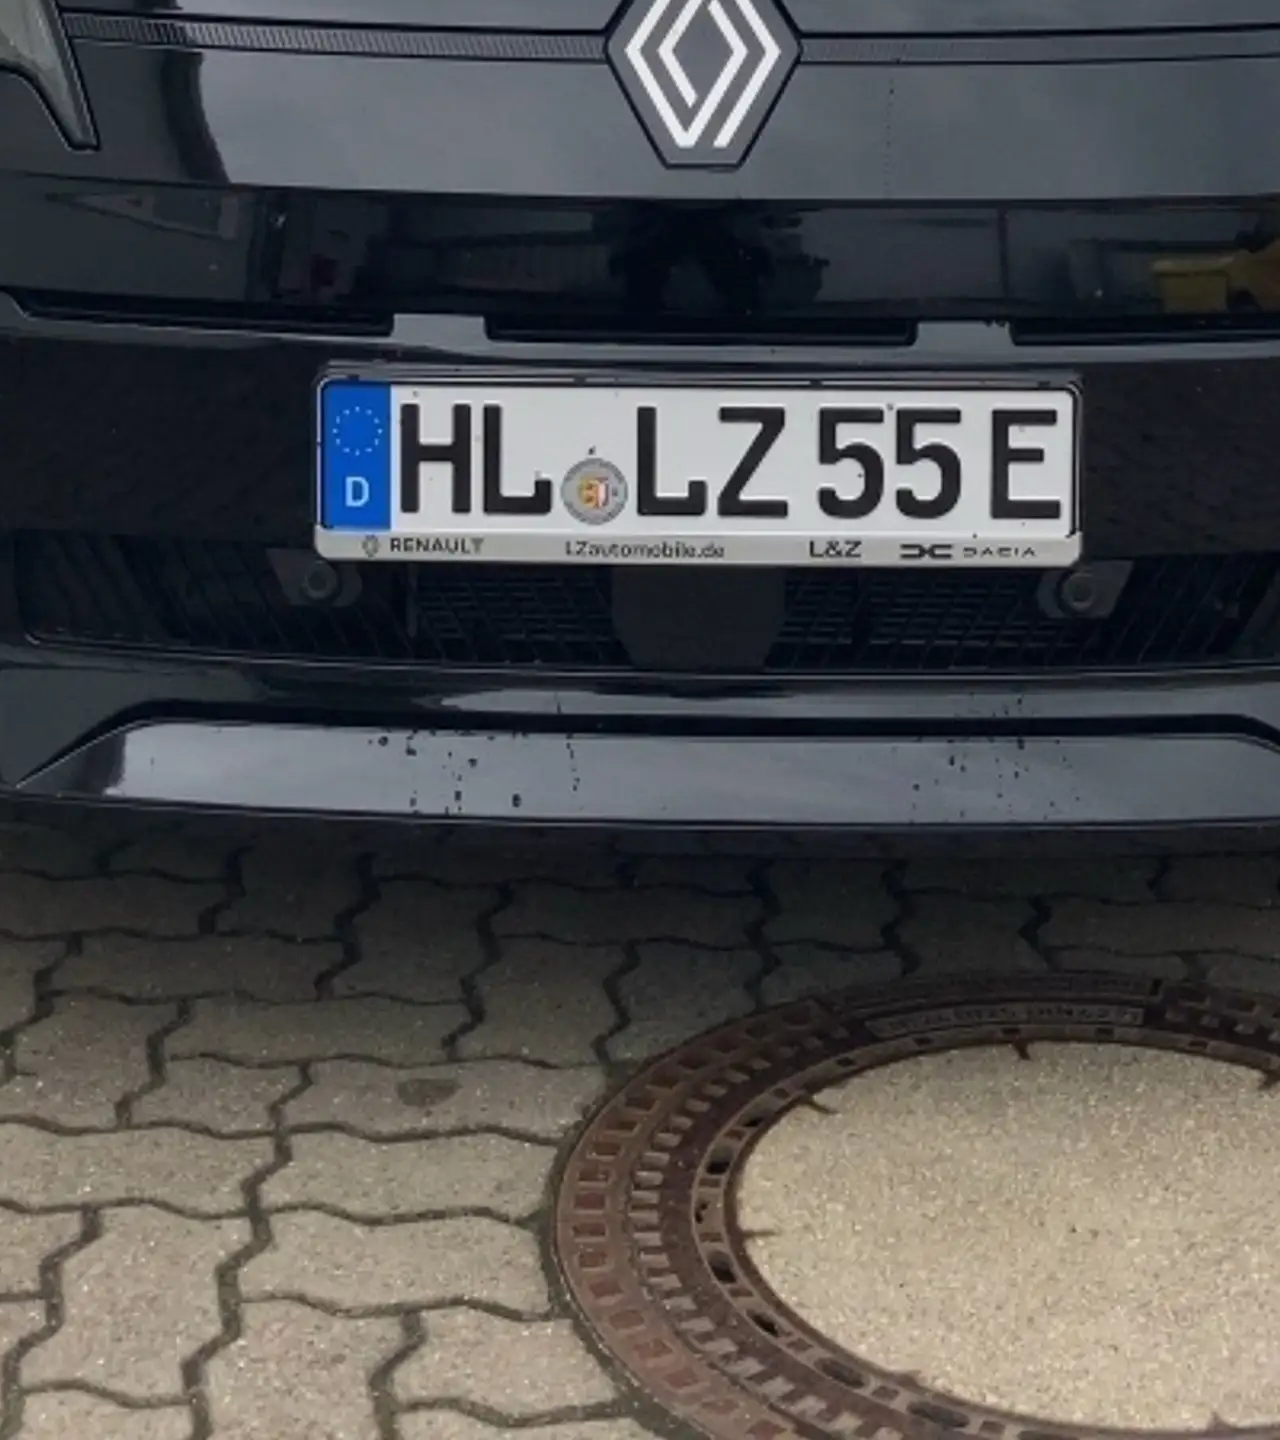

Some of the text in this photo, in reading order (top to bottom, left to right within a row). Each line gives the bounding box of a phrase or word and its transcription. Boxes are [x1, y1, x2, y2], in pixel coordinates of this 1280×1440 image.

[400, 403, 553, 516] HL
[636, 406, 789, 519] LZ
[345, 476, 369, 508] D
[389, 537, 484, 555] RENAULT
[564, 540, 725, 559] LZautomobile.de
[809, 540, 863, 559] L&Z
